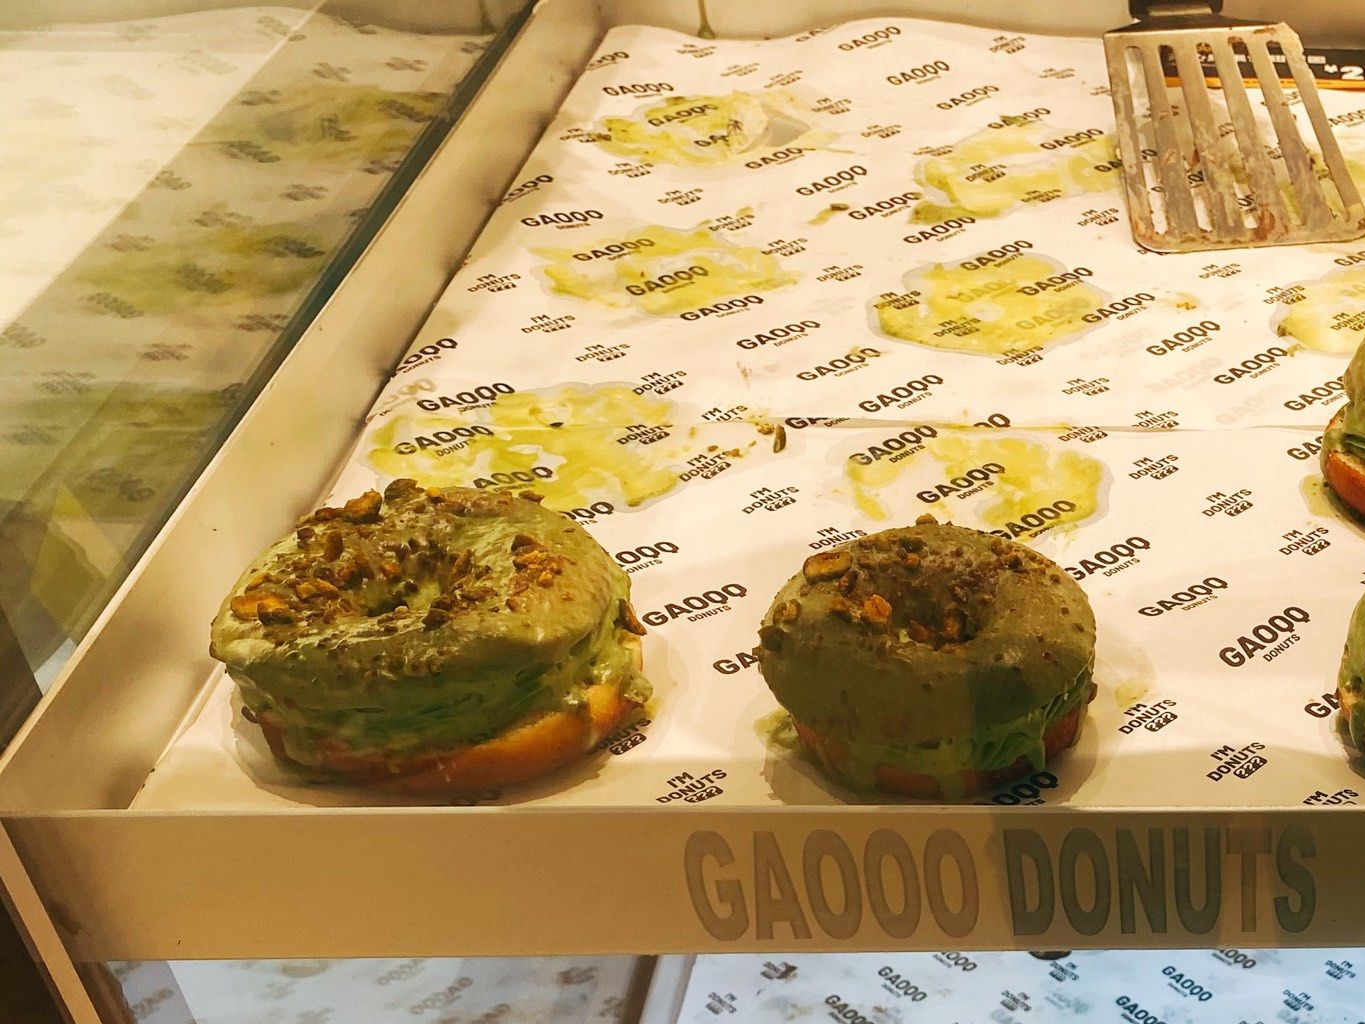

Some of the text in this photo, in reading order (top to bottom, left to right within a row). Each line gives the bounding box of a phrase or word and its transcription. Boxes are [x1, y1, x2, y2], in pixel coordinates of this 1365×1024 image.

[632, 371, 686, 395] DONUTS
[889, 445, 925, 463] DONUTS
[1129, 455, 1178, 479] DONUTS
[742, 487, 799, 514] DONUTS
[957, 481, 994, 499] DONUTS
[1202, 490, 1252, 517] DONUTS
[1279, 528, 1329, 555] DONUTS
[1103, 558, 1140, 577] DONUTS
[688, 604, 732, 622] DONUTS
[1263, 634, 1300, 662] DONUTS
[1118, 700, 1176, 734] DONUTS
[1206, 743, 1265, 782] DONUTS
[1003, 827, 1317, 937] DONUTS
